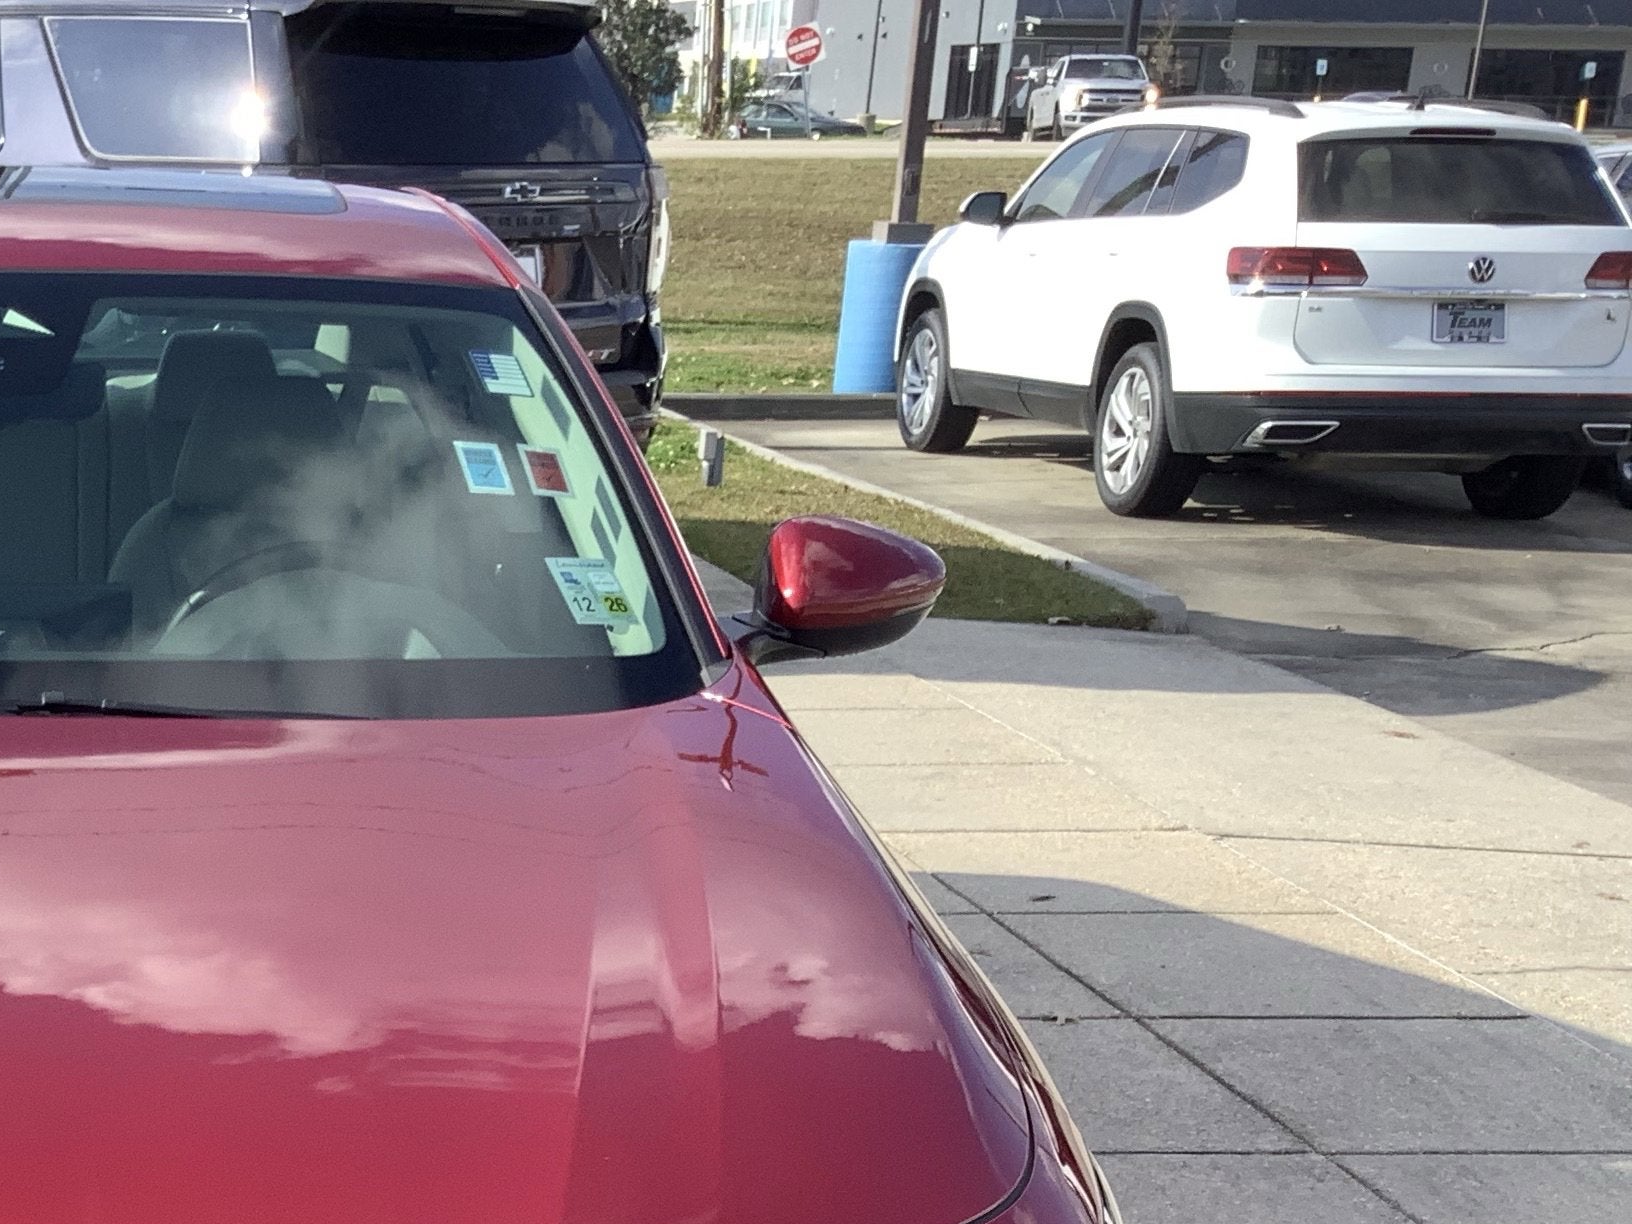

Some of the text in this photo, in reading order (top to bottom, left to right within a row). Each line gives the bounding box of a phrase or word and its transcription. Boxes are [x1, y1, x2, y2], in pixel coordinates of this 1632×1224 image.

[799, 31, 814, 41] NOT
[795, 47, 816, 61] ENTER
[1449, 311, 1493, 329] TEAM
[573, 596, 596, 612] 12
